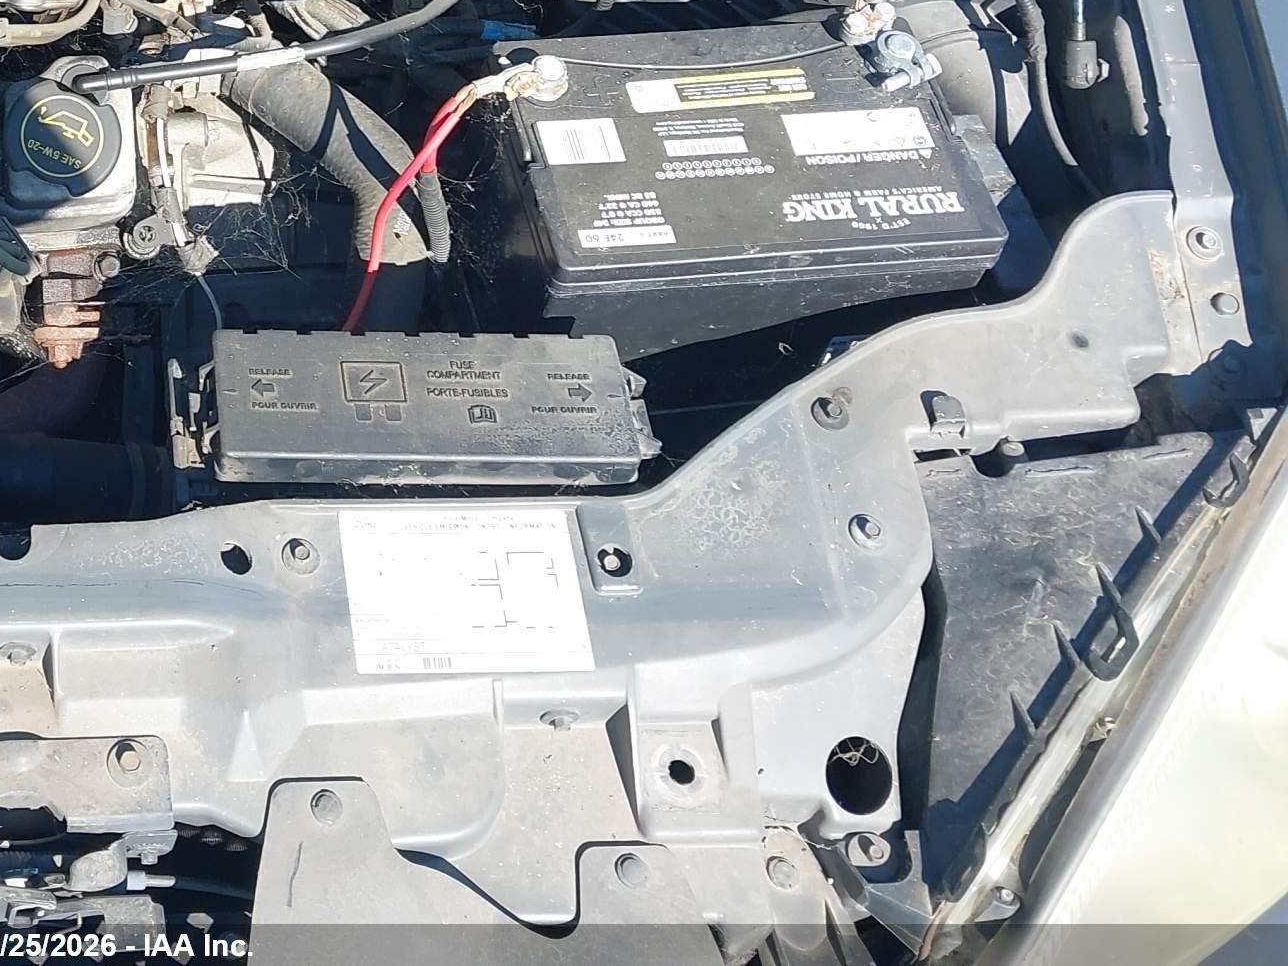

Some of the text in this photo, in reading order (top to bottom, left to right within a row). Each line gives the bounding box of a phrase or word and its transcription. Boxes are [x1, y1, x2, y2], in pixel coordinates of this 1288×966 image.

[27, 139, 82, 170] SAE 5W-20
[782, 192, 965, 222] RURAL KING
[449, 360, 475, 370] FUSE
[248, 368, 292, 377] RELEASE
[427, 370, 501, 380] COMPARTMENT
[547, 373, 591, 381] RELEASE
[426, 387, 509, 398] PORTE-FUSIBLES
[251, 401, 279, 410] POUR
[531, 406, 559, 414] POUR
